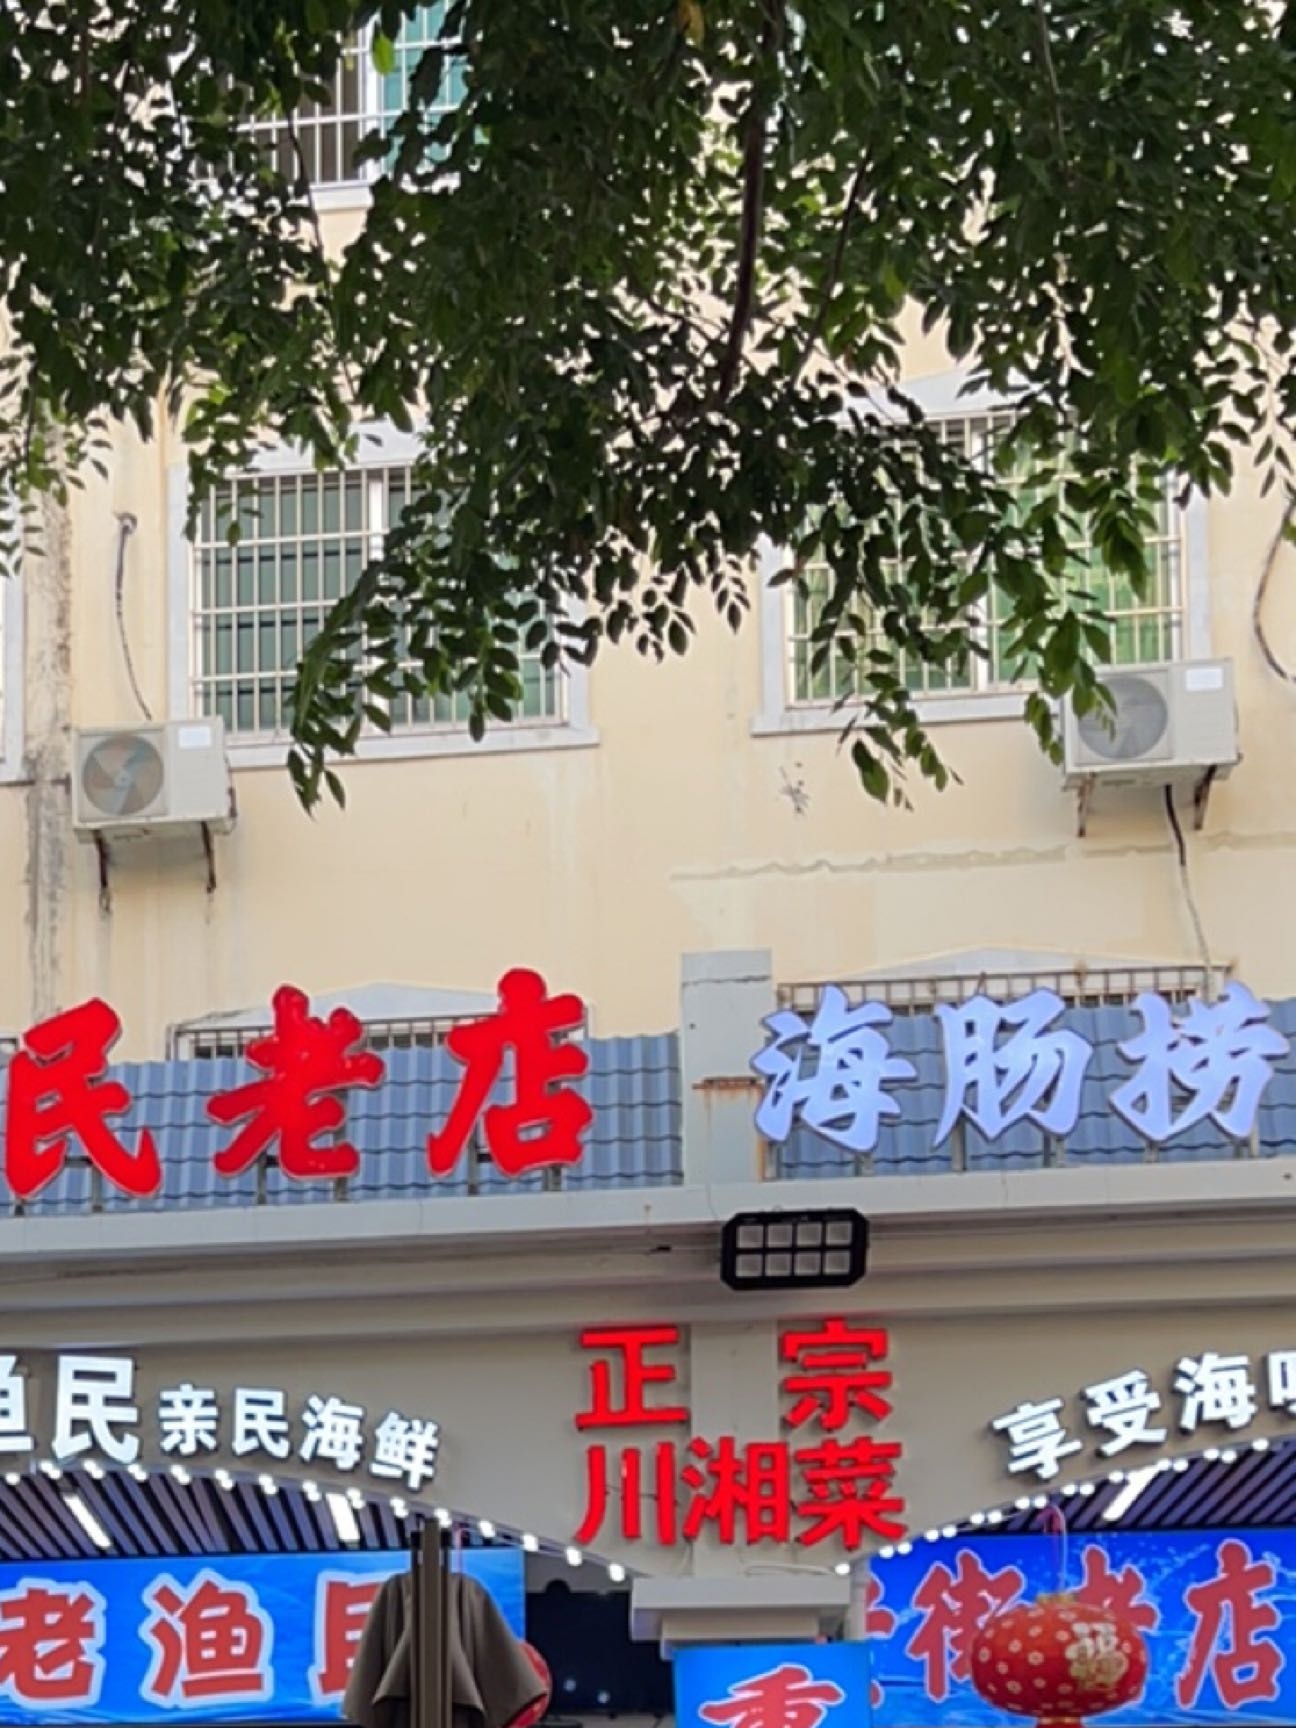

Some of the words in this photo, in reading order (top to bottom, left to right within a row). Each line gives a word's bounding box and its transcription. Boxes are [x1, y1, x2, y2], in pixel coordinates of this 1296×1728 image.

[748, 982, 1290, 1152] 海肠捞
[575, 1437, 907, 1551] 川湘菜
